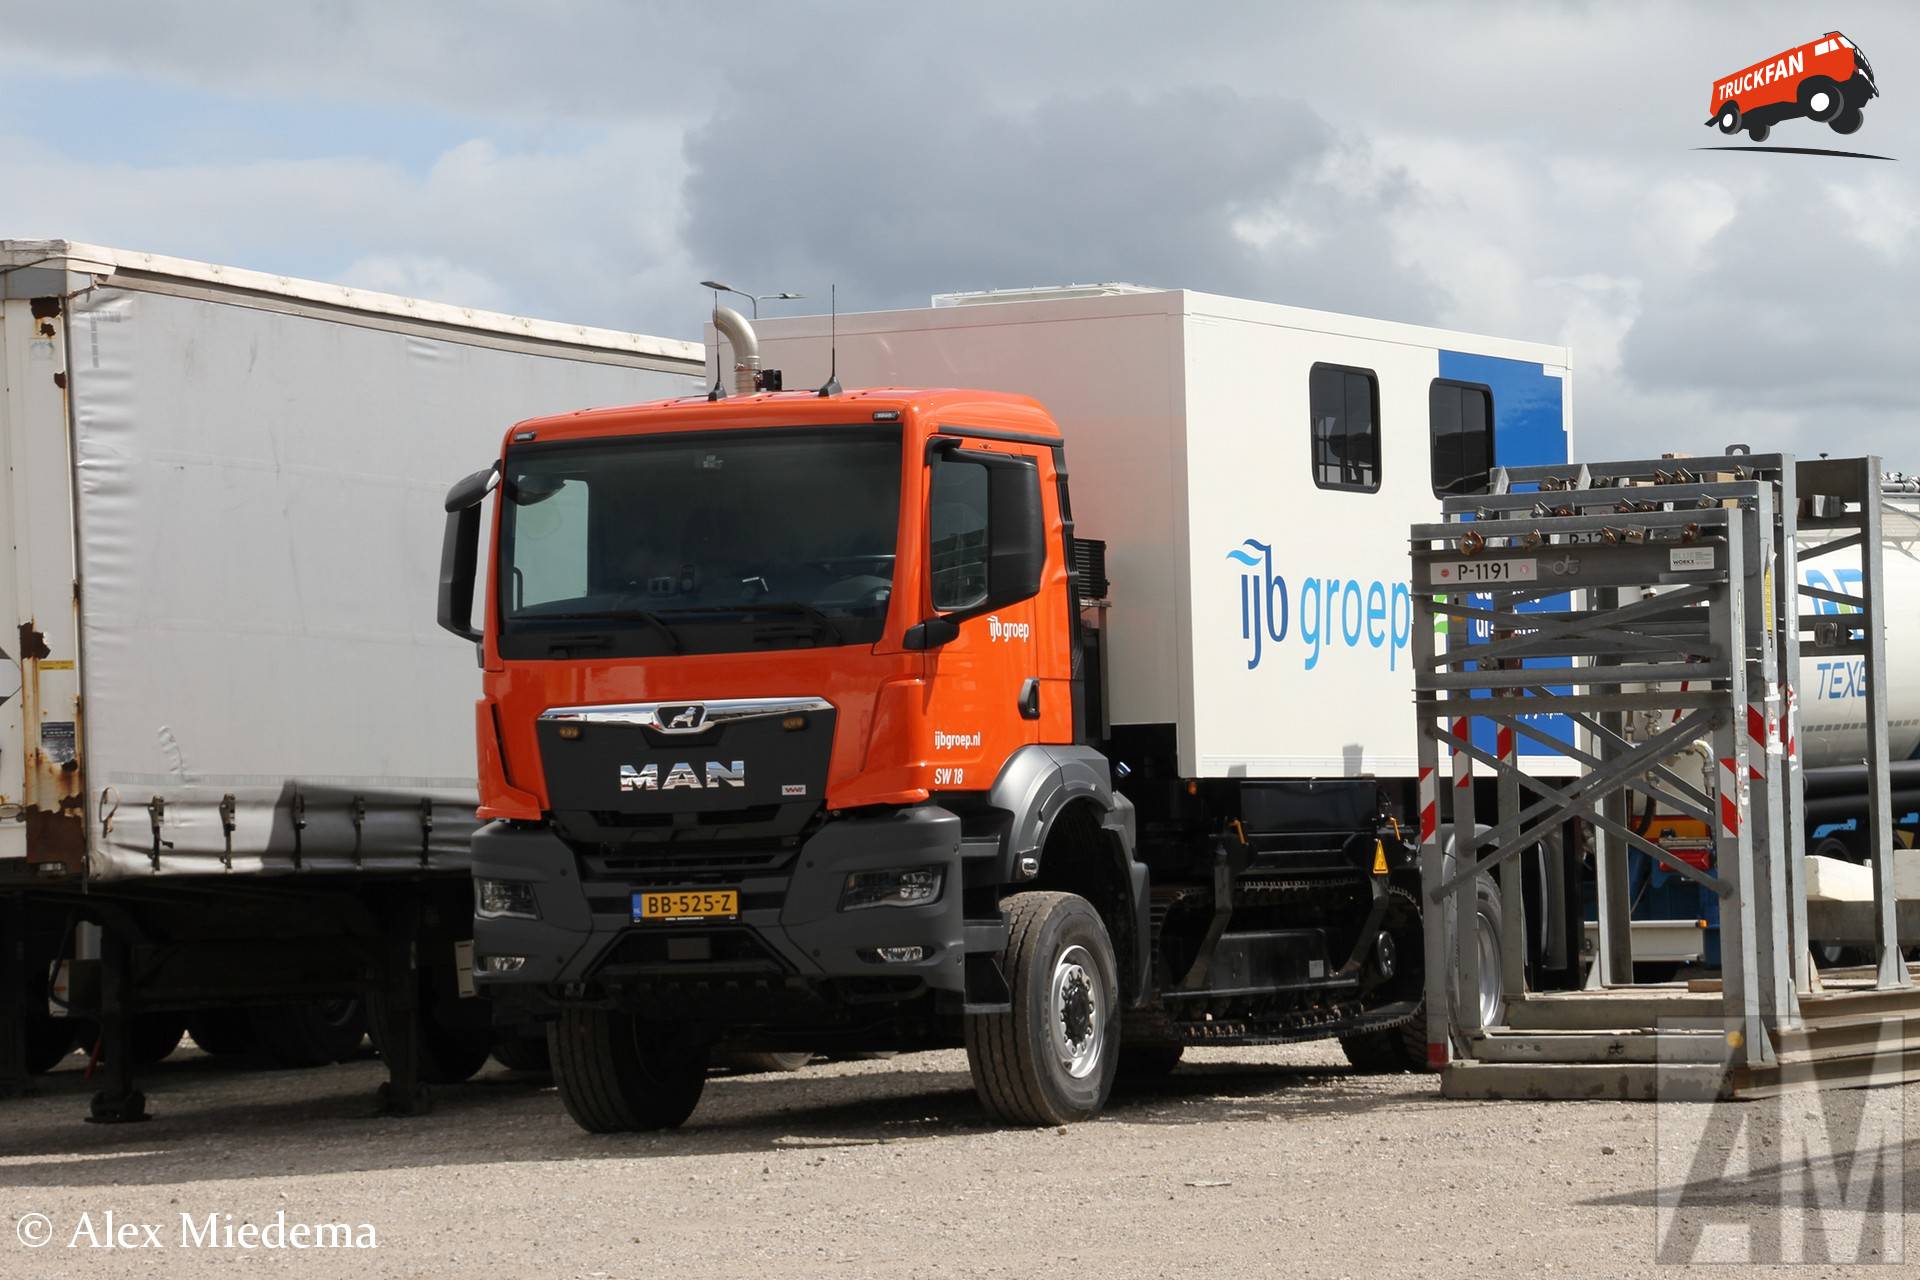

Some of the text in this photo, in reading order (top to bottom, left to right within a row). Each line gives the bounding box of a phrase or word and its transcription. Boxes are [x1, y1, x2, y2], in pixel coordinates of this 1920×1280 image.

[1457, 562, 1509, 581] P-1191
[1239, 539, 1289, 670] ijb
[1300, 577, 1410, 672] groep
[988, 616, 1029, 642] ijb groep
[934, 731, 981, 750] ijbgroep.nl
[620, 760, 745, 791] MAN
[935, 768, 963, 784] SW 18
[648, 894, 731, 914] BB-525-Z
